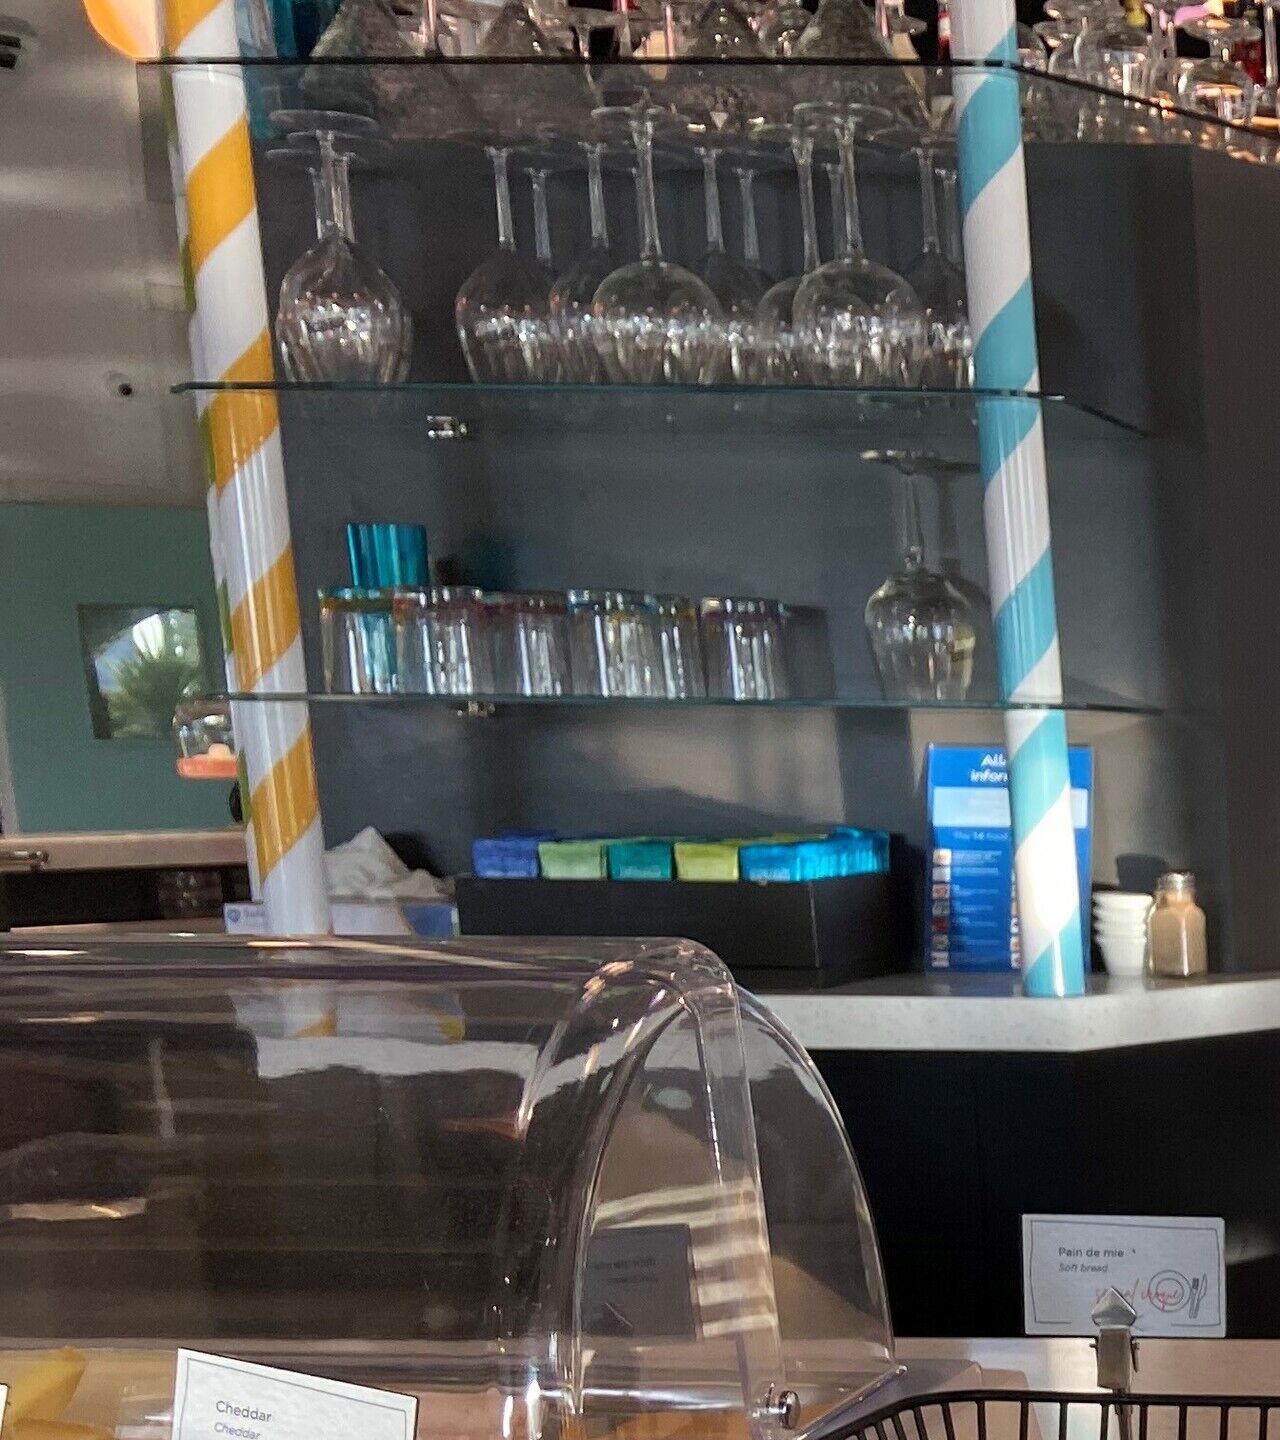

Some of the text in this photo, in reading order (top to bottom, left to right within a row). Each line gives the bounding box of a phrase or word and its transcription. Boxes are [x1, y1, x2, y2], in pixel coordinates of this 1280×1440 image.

[1058, 1247, 1124, 1258] Pain de mie
[216, 1400, 272, 1422] Cheddar
[214, 1421, 261, 1440] Cheddar
